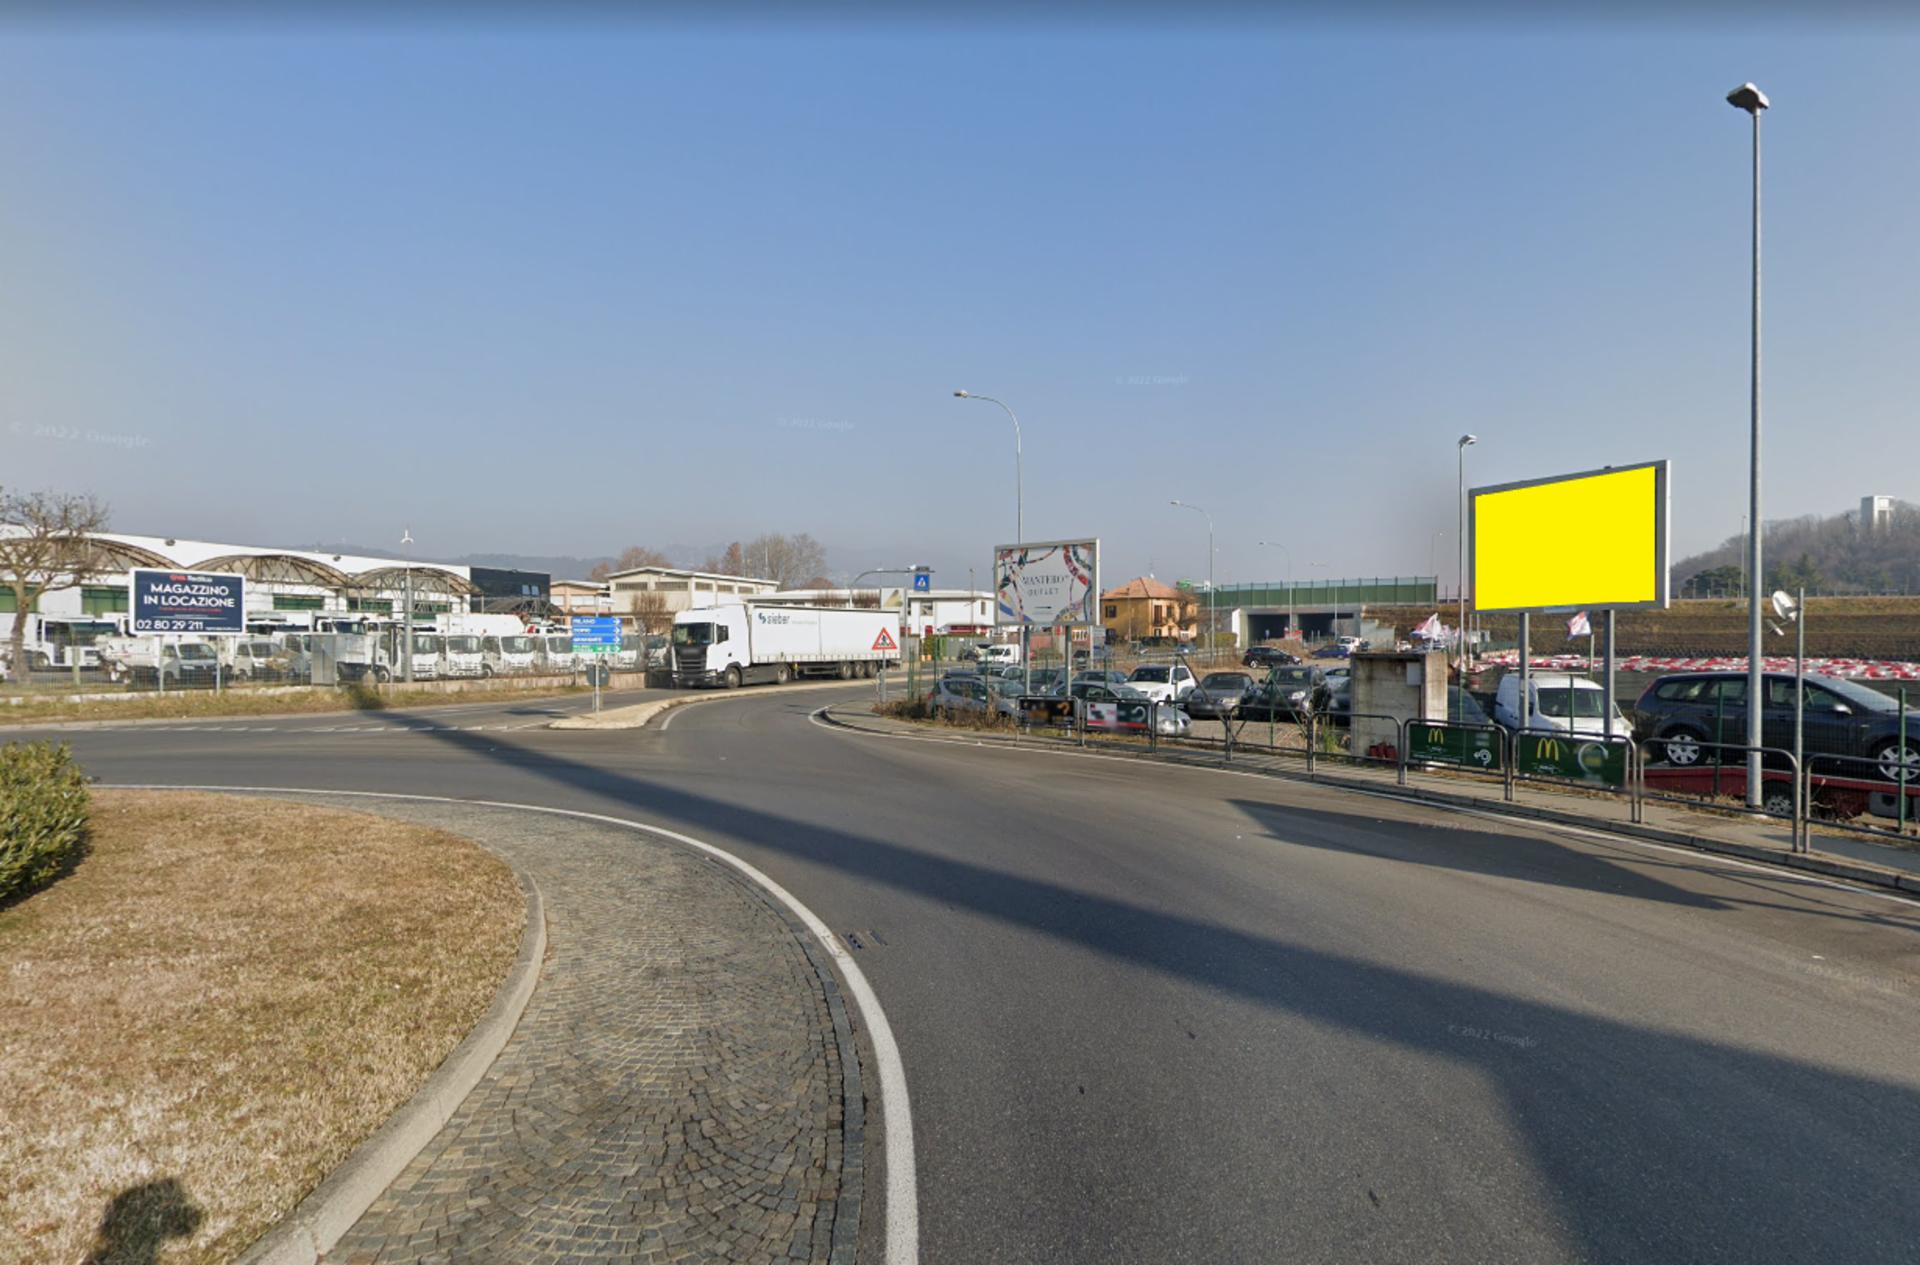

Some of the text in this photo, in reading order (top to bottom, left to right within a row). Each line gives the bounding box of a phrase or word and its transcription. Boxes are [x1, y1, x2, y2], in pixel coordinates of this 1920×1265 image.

[150, 583, 229, 596] MAGAZZINO
[144, 595, 235, 608] IN LOCAZIONE
[136, 619, 152, 630] 02
[153, 620, 170, 630] 80
[172, 620, 186, 631] 29
[188, 620, 204, 631] 211
